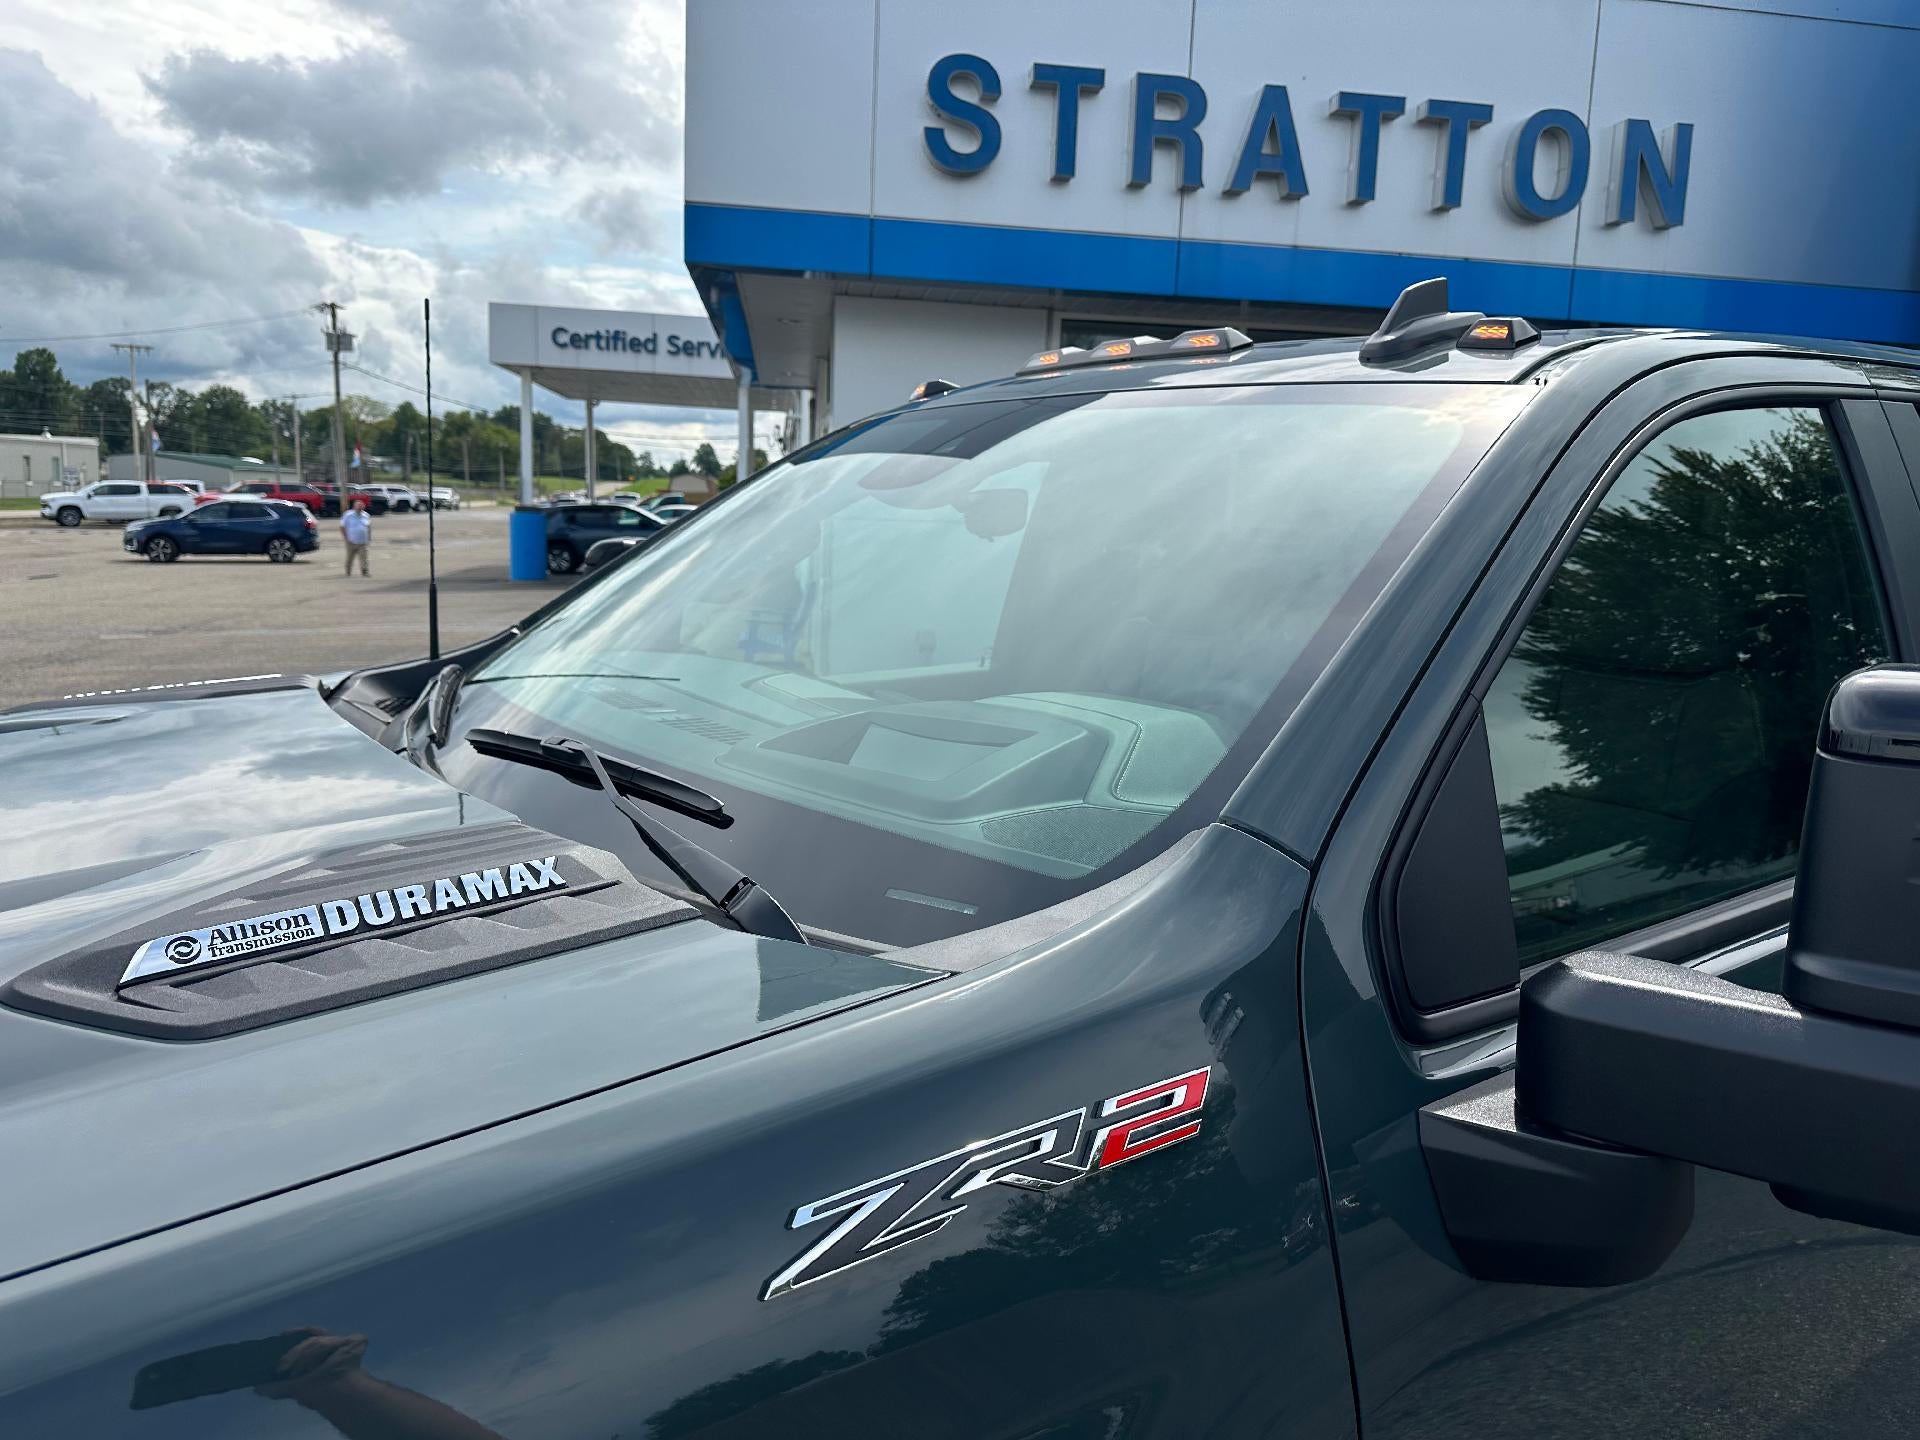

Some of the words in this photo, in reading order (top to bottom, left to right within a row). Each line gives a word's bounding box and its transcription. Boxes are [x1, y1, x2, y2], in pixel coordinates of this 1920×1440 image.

[924, 53, 1694, 229] STRATTON
[551, 326, 658, 354] Certified
[322, 856, 567, 936] DURAMAX
[207, 911, 312, 947] Allison
[207, 927, 316, 958] Transmission
[761, 1066, 1211, 1300] ZR2
